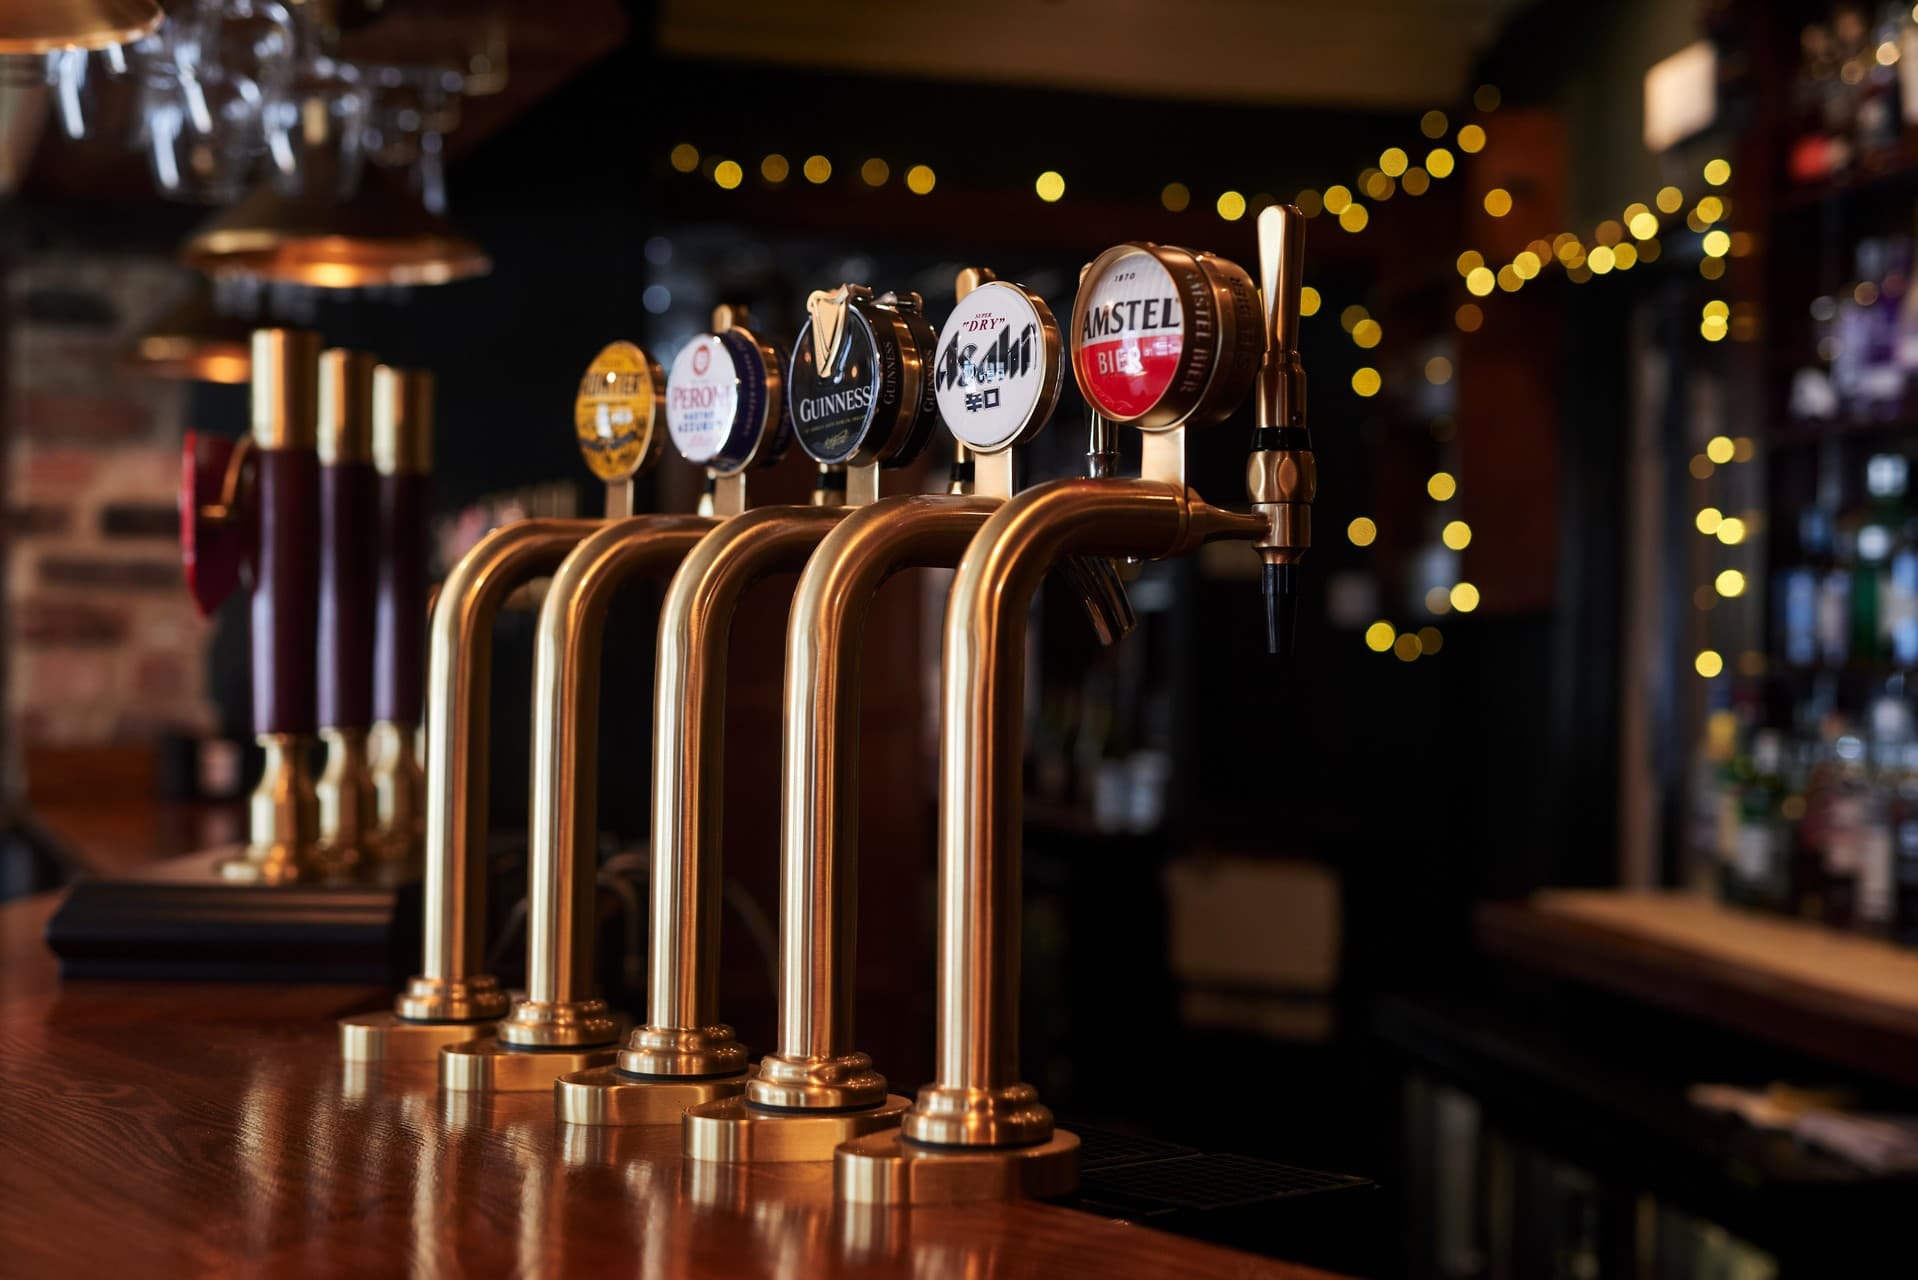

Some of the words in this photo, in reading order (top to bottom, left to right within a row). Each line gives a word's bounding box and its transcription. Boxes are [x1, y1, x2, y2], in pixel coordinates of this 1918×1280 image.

[1114, 272, 1136, 283] 1870
[1082, 298, 1180, 341] AMSTEL
[883, 340, 898, 405] GUINNESS
[922, 349, 936, 412] GUINNESS
[1097, 347, 1143, 375] BIER
[800, 385, 872, 423] GUINNESS
